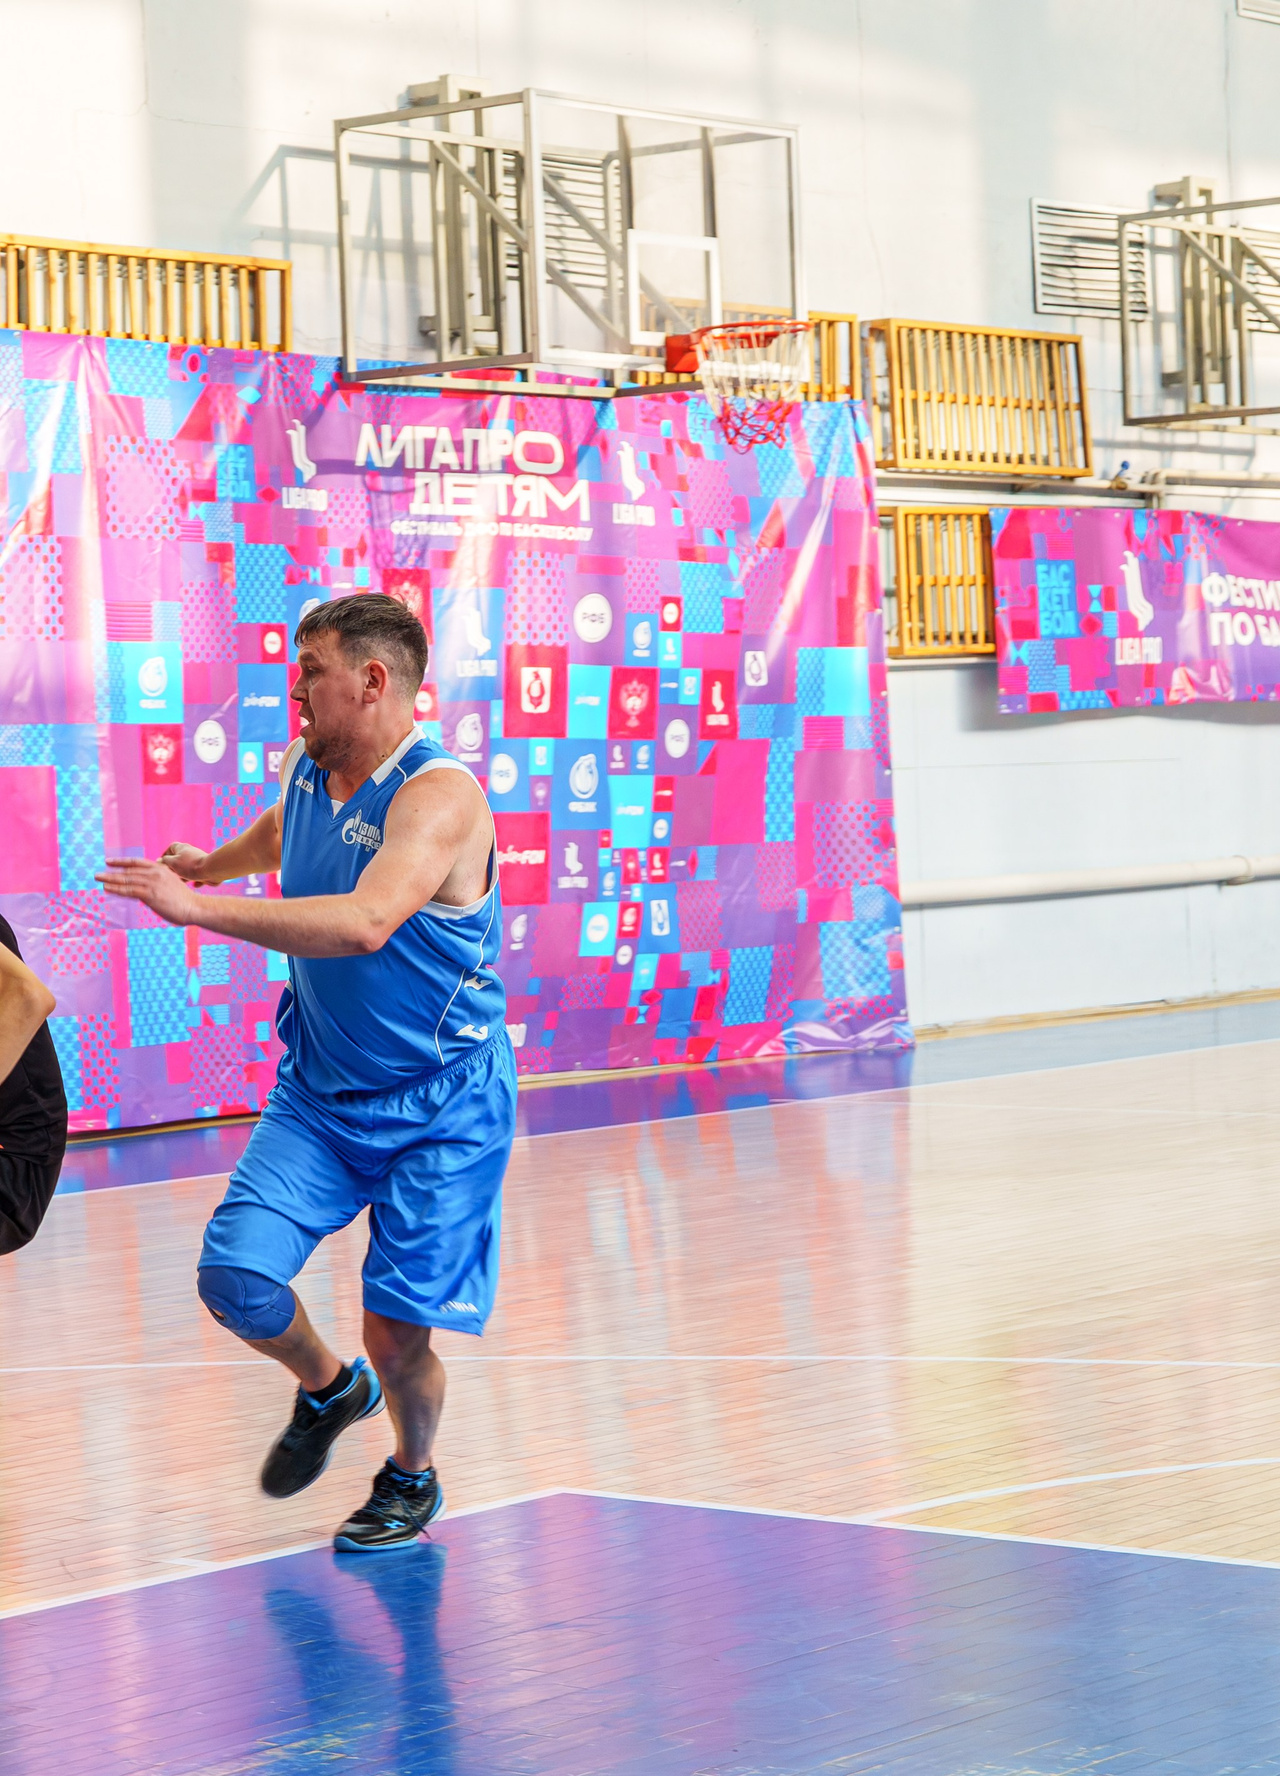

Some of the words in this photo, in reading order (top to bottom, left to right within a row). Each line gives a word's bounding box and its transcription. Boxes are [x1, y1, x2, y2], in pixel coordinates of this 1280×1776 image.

[408, 471, 591, 522] ДЕТЯМ
[1036, 564, 1070, 588] БАС
[1038, 588, 1070, 611] КЕТ
[1201, 572, 1280, 612] ФЕСТИ
[1040, 611, 1076, 635] БОЛ
[1210, 611, 1256, 647] ПО
